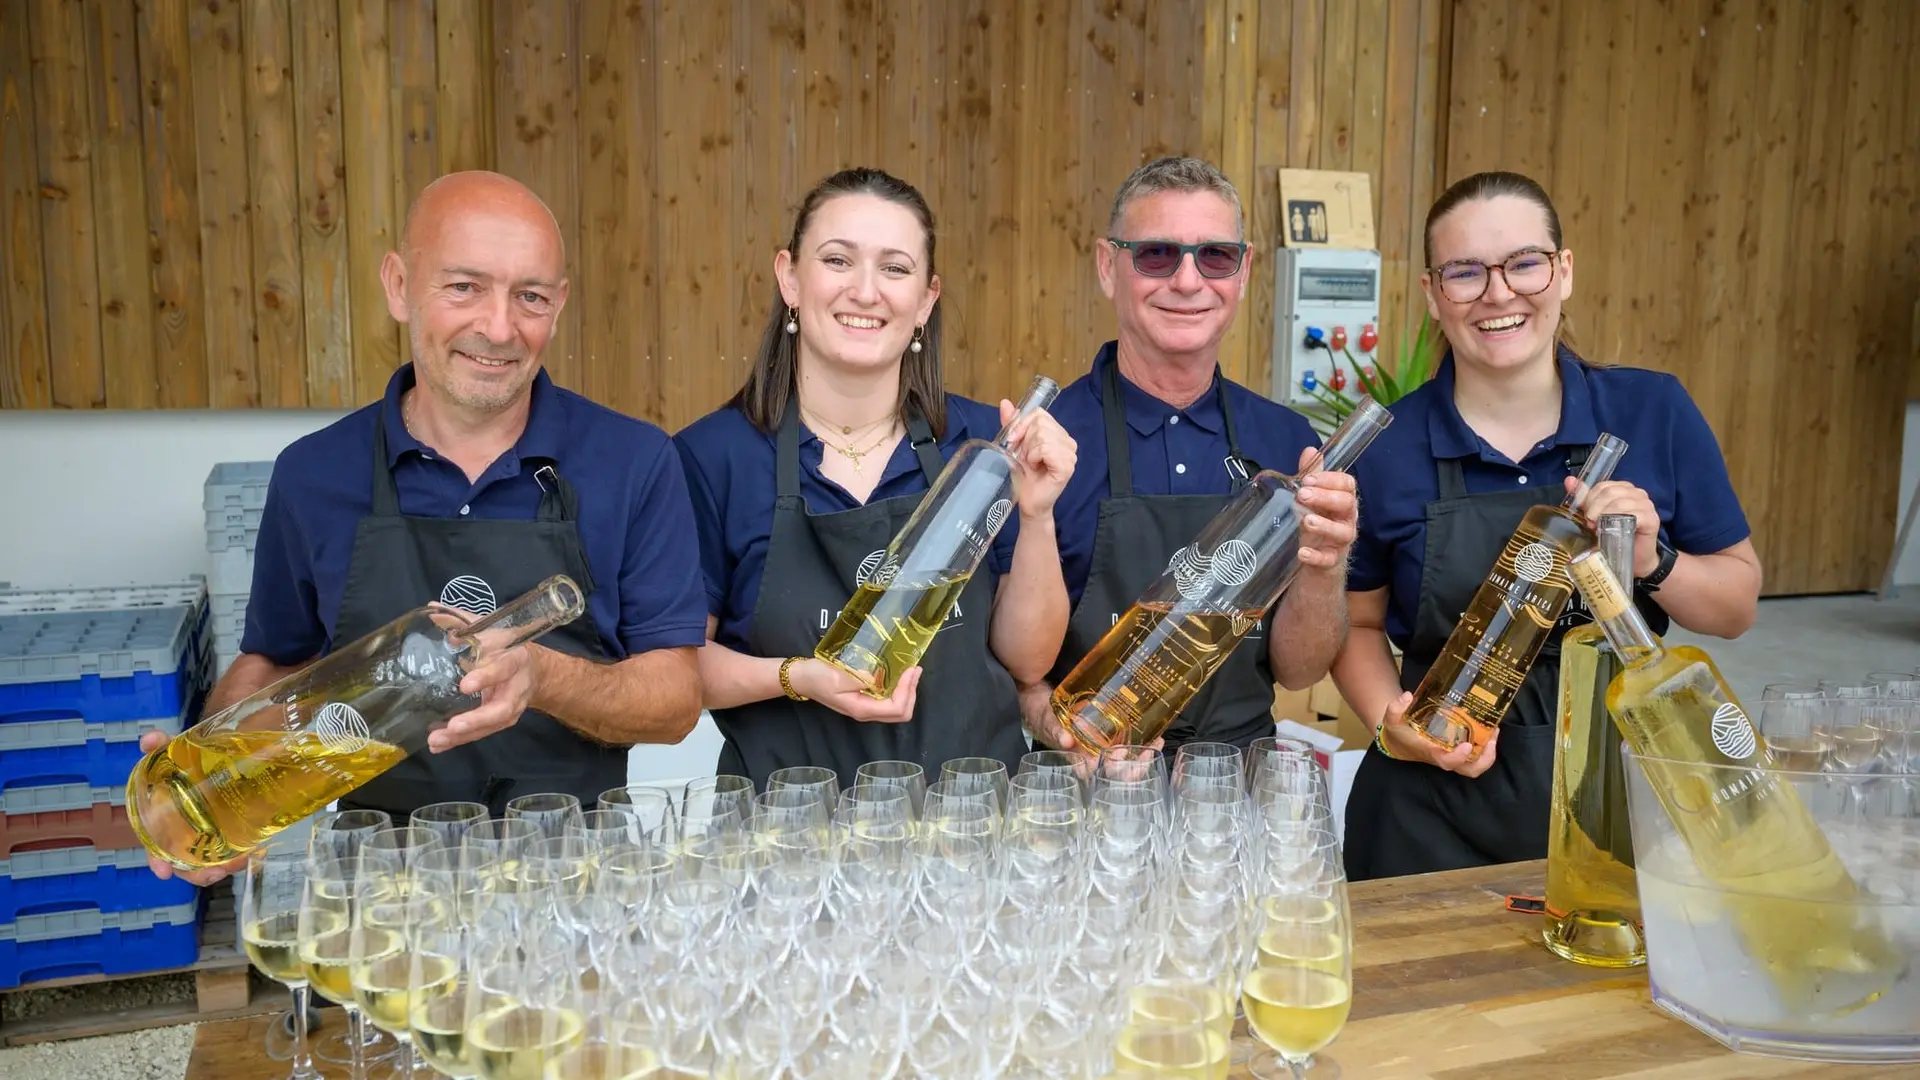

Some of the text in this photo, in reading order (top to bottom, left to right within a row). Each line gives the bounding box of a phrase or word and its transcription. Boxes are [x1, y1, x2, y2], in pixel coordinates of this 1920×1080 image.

[1489, 573, 1520, 594] DOMAINE
[1524, 592, 1552, 612] ARICA
[286, 693, 314, 753] DOMAINE
[1712, 762, 1766, 804] DOMAINE
